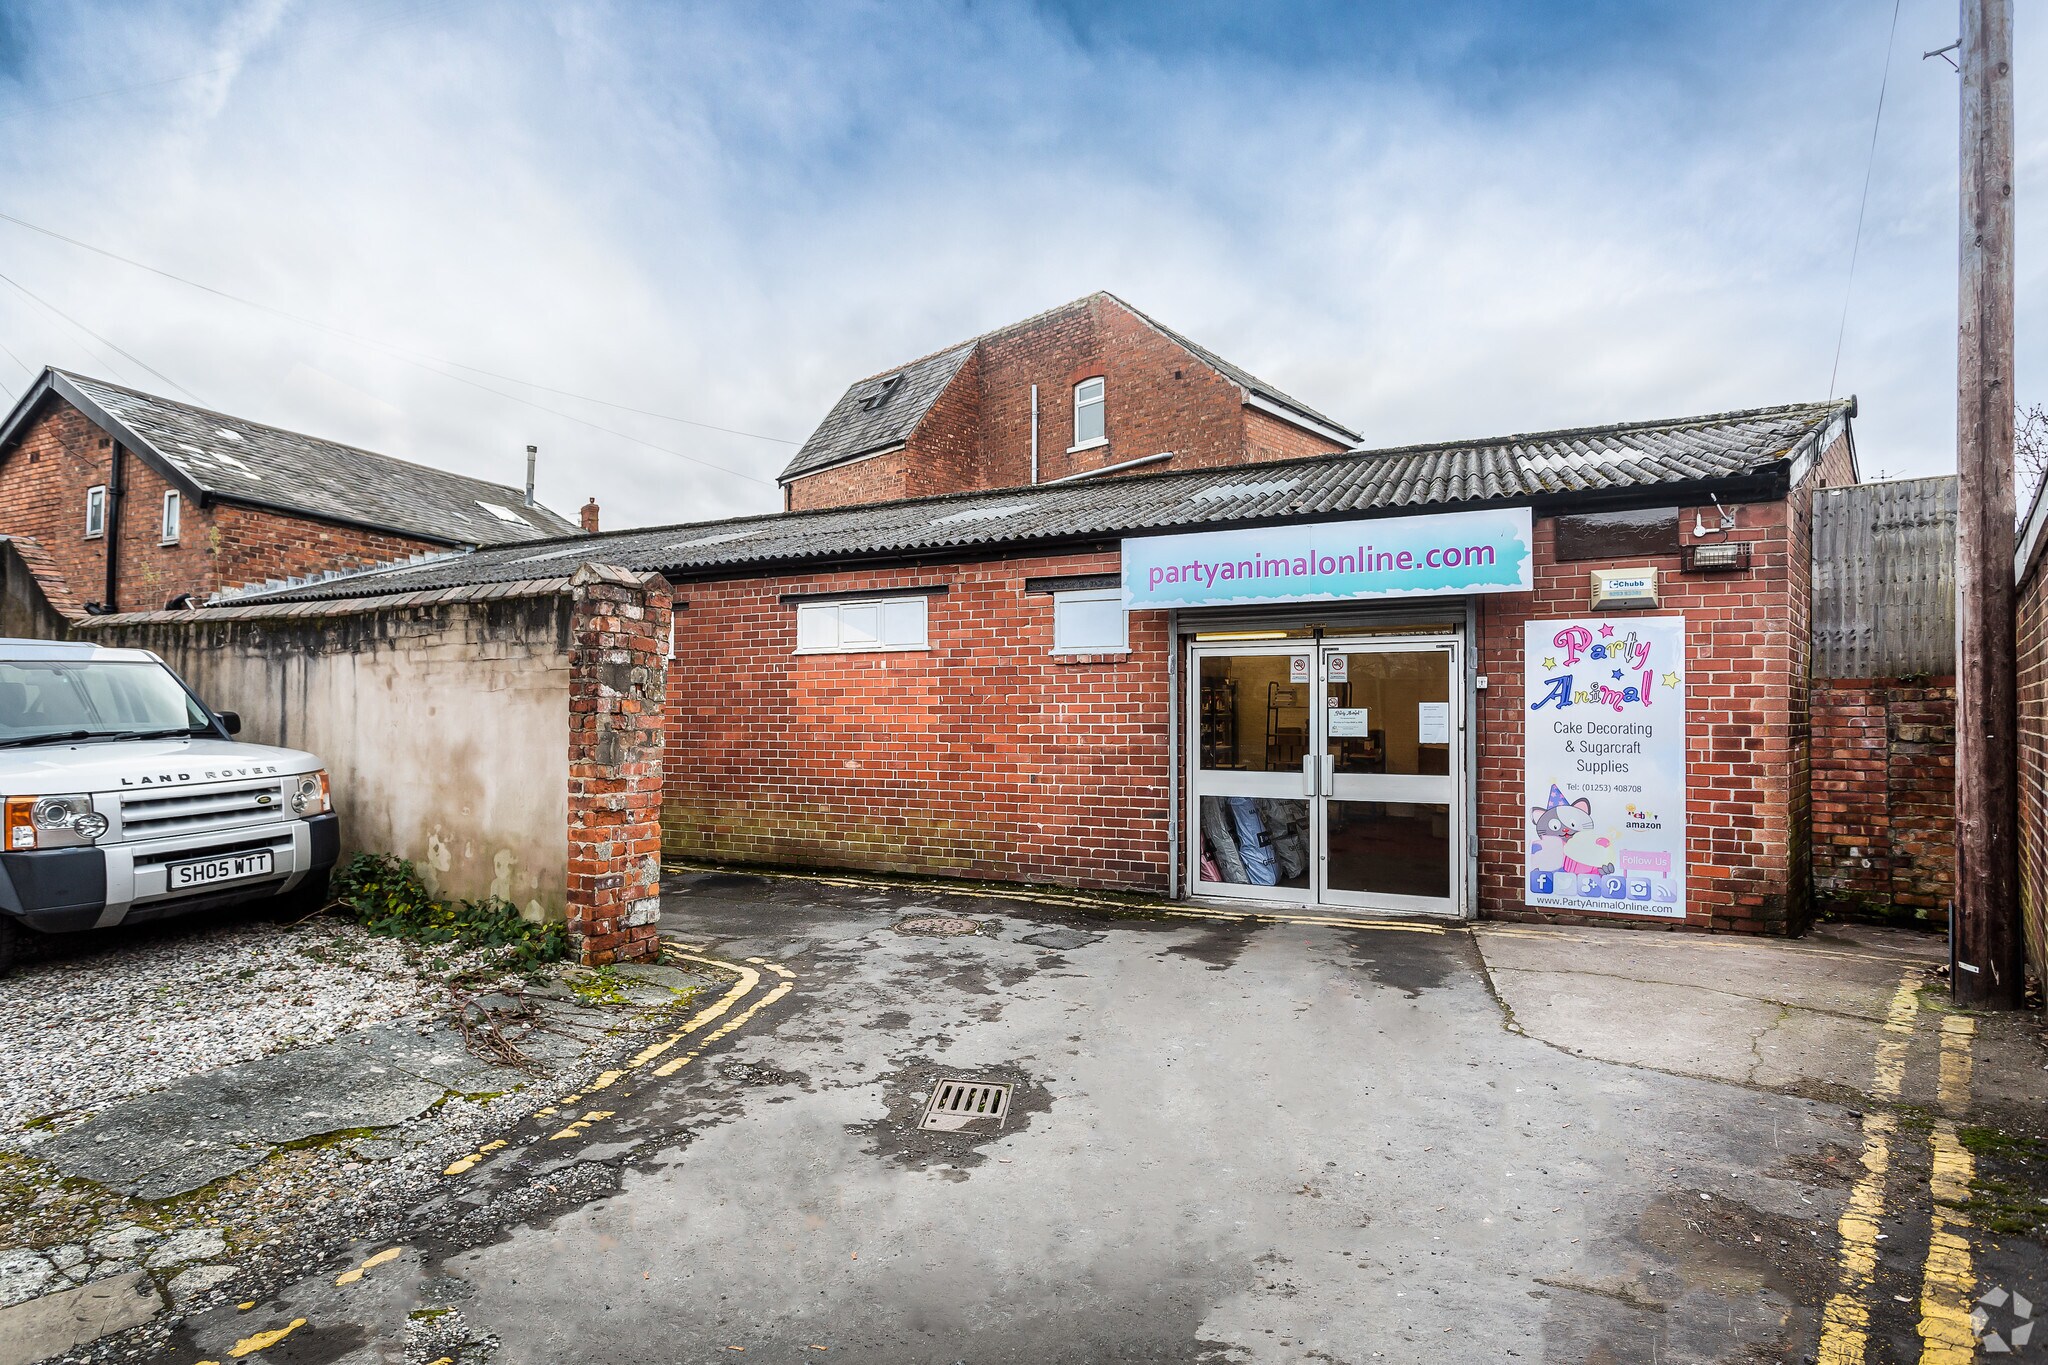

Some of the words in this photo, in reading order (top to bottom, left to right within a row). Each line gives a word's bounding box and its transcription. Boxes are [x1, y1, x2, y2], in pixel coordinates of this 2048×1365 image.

[1149, 543, 1495, 592] partyanimalonline.com
[1618, 580, 1645, 588] Chubb
[1552, 625, 1652, 671] Party
[1530, 669, 1654, 713] Animal
[1553, 721, 1583, 734] Cake
[1587, 721, 1653, 738] Decorating
[1565, 739, 1575, 753] &
[1579, 740, 1641, 756] Sugarcraft
[1576, 758, 1629, 775] Supplies
[121, 773, 191, 786] LAND
[205, 766, 278, 779] ROVER
[1567, 783, 1580, 791] Tel:
[1582, 783, 1612, 794] (01253)
[1614, 784, 1642, 793] 408708
[1626, 821, 1662, 829] amazon
[1622, 855, 1652, 865] Follow
[1655, 857, 1667, 866] Us
[180, 860, 229, 884] SH05
[234, 855, 266, 876] WTT
[1536, 896, 1673, 914] www.PartyAnimalOnline.com
